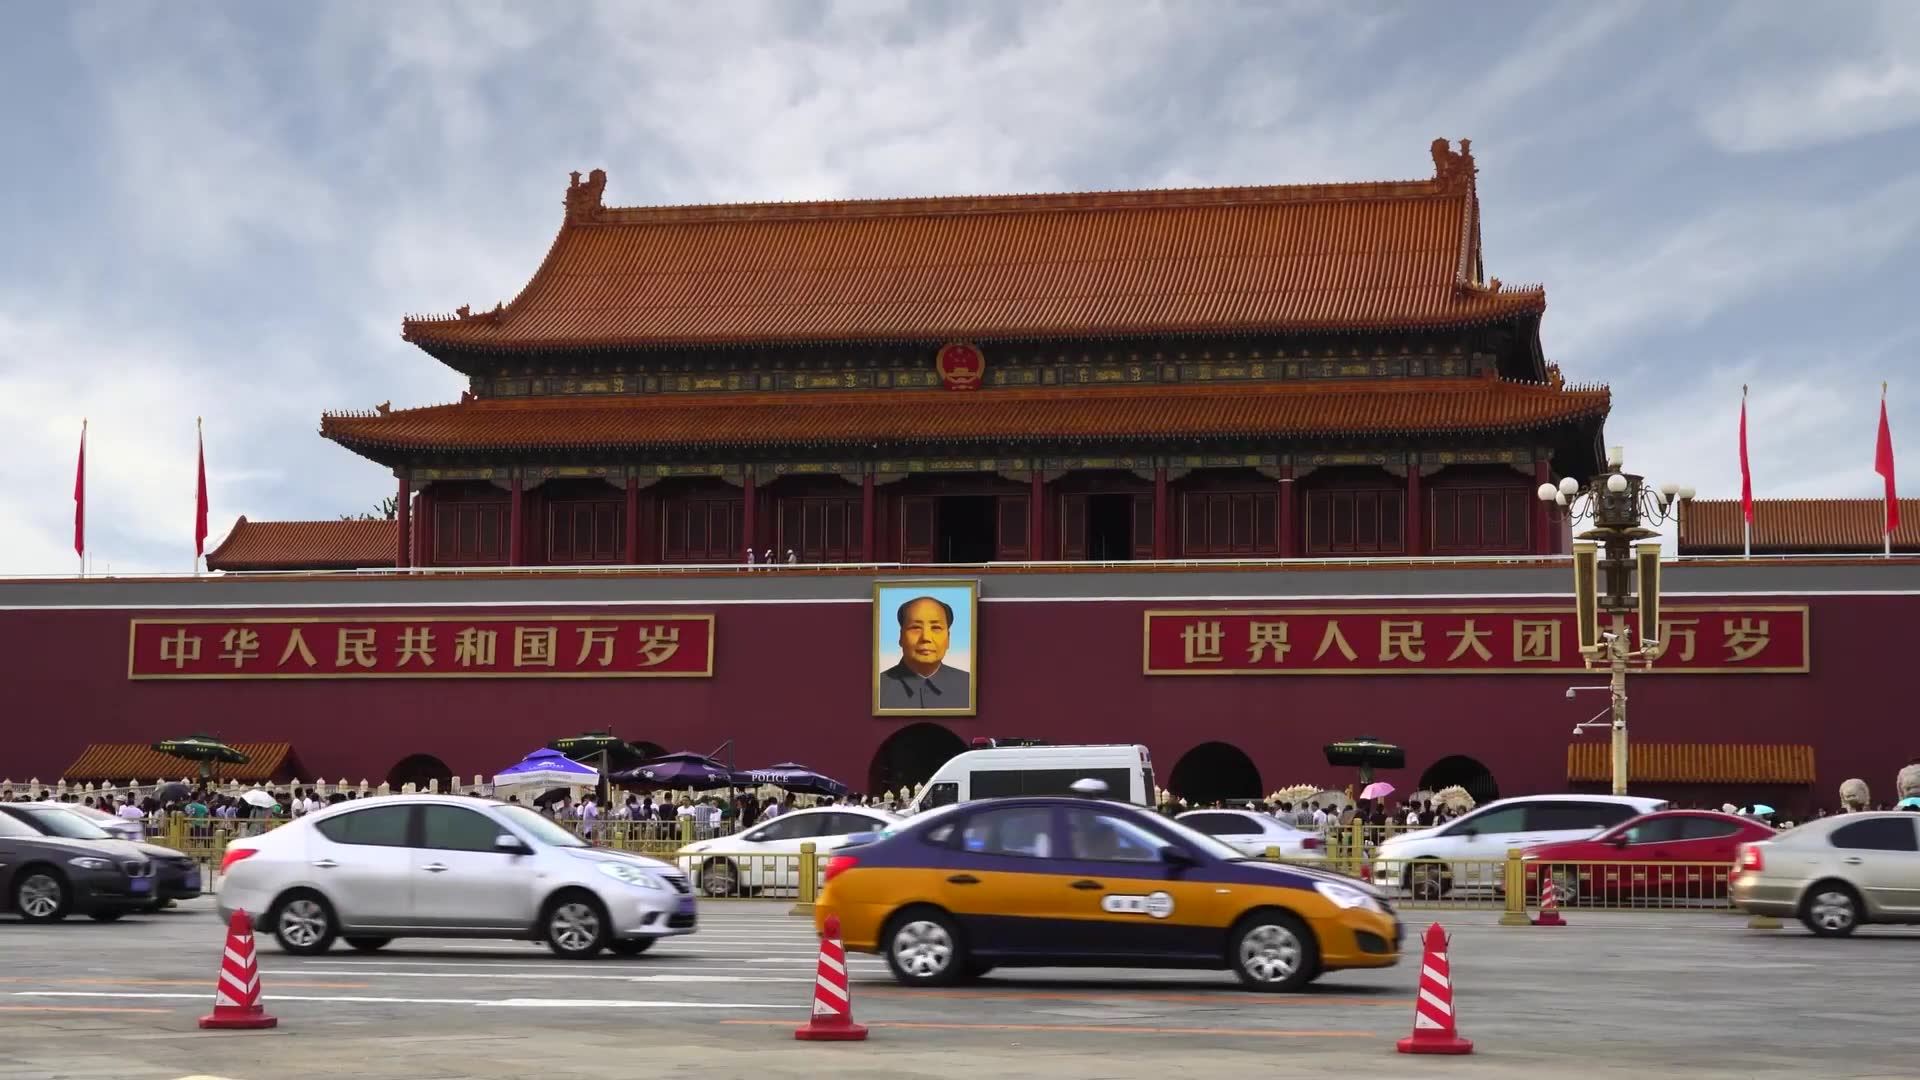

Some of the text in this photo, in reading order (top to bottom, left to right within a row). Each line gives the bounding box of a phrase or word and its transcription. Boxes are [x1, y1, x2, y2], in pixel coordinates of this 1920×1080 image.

[159, 626, 681, 668] 中华人民共和国万岁
[1180, 619, 1771, 663] 世界人民大团万岁
[751, 774, 789, 783] POLICE
